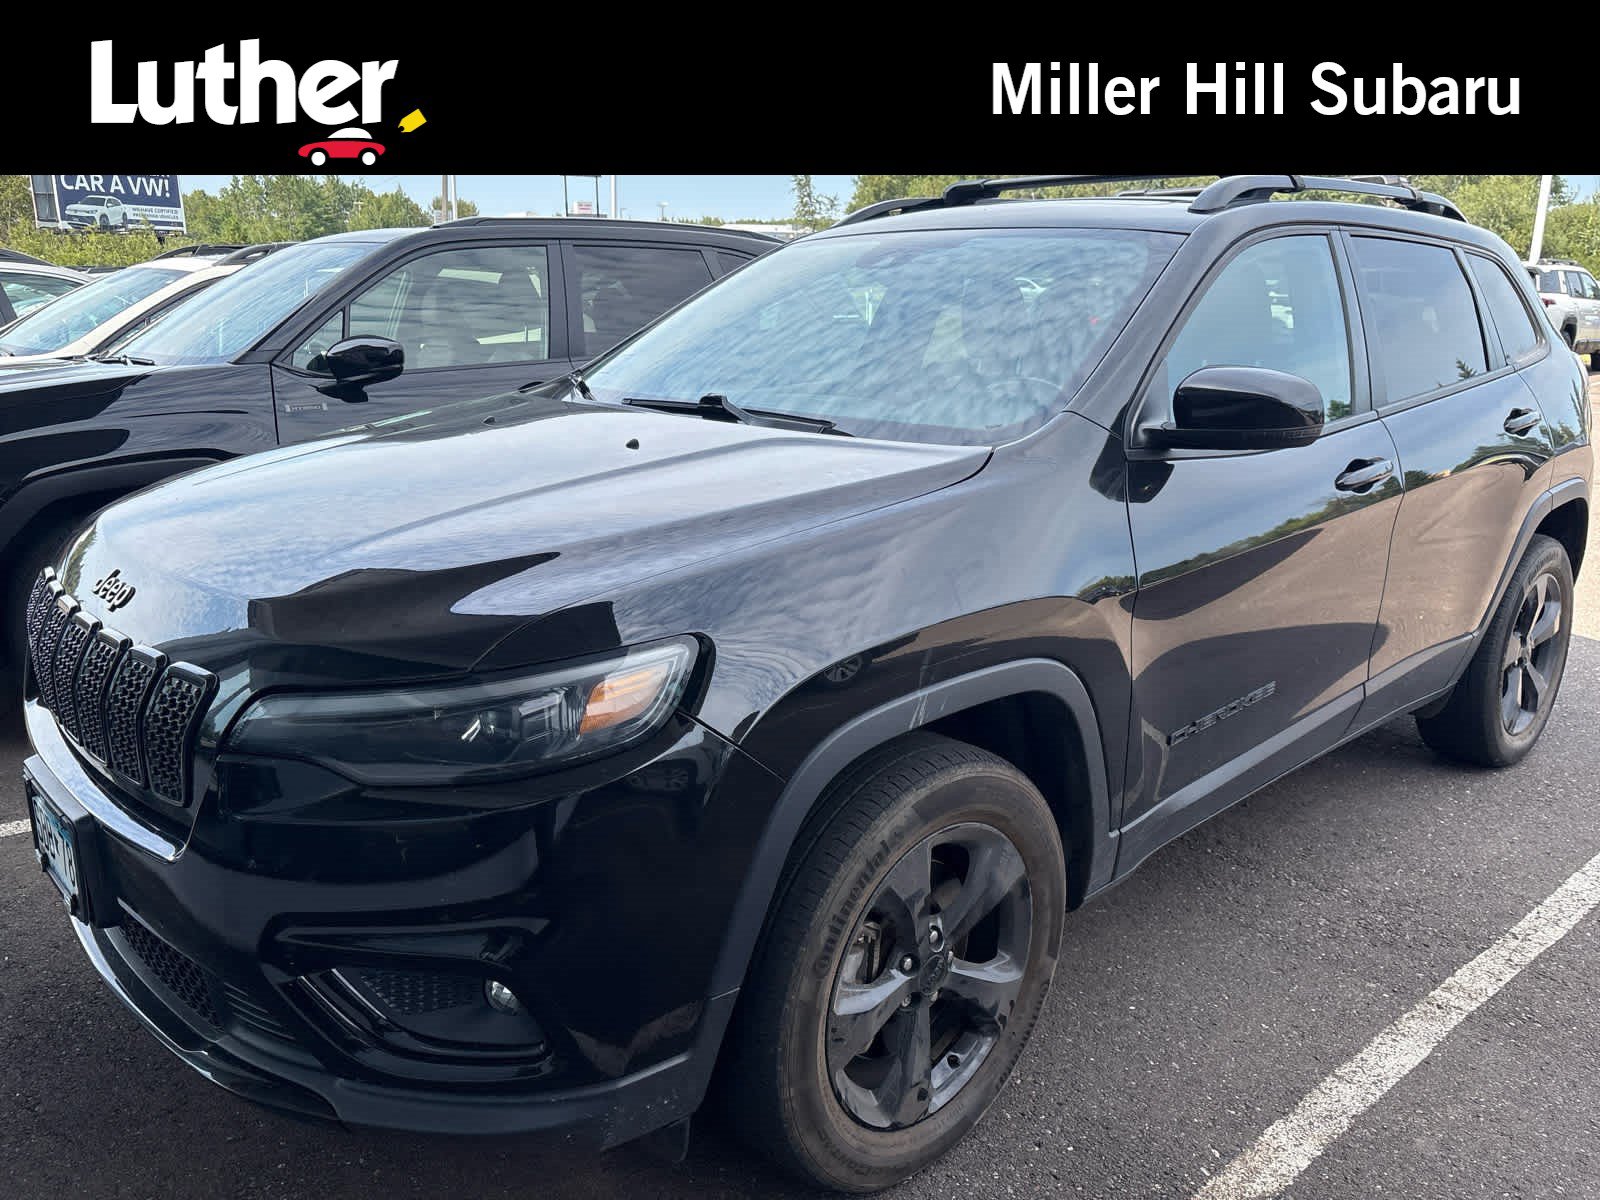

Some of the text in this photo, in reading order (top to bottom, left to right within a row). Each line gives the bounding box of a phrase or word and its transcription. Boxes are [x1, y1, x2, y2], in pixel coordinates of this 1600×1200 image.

[61, 175, 170, 198] CAR A VW!
[93, 569, 136, 613] Jeep
[1170, 681, 1276, 746] CHEROKEE
